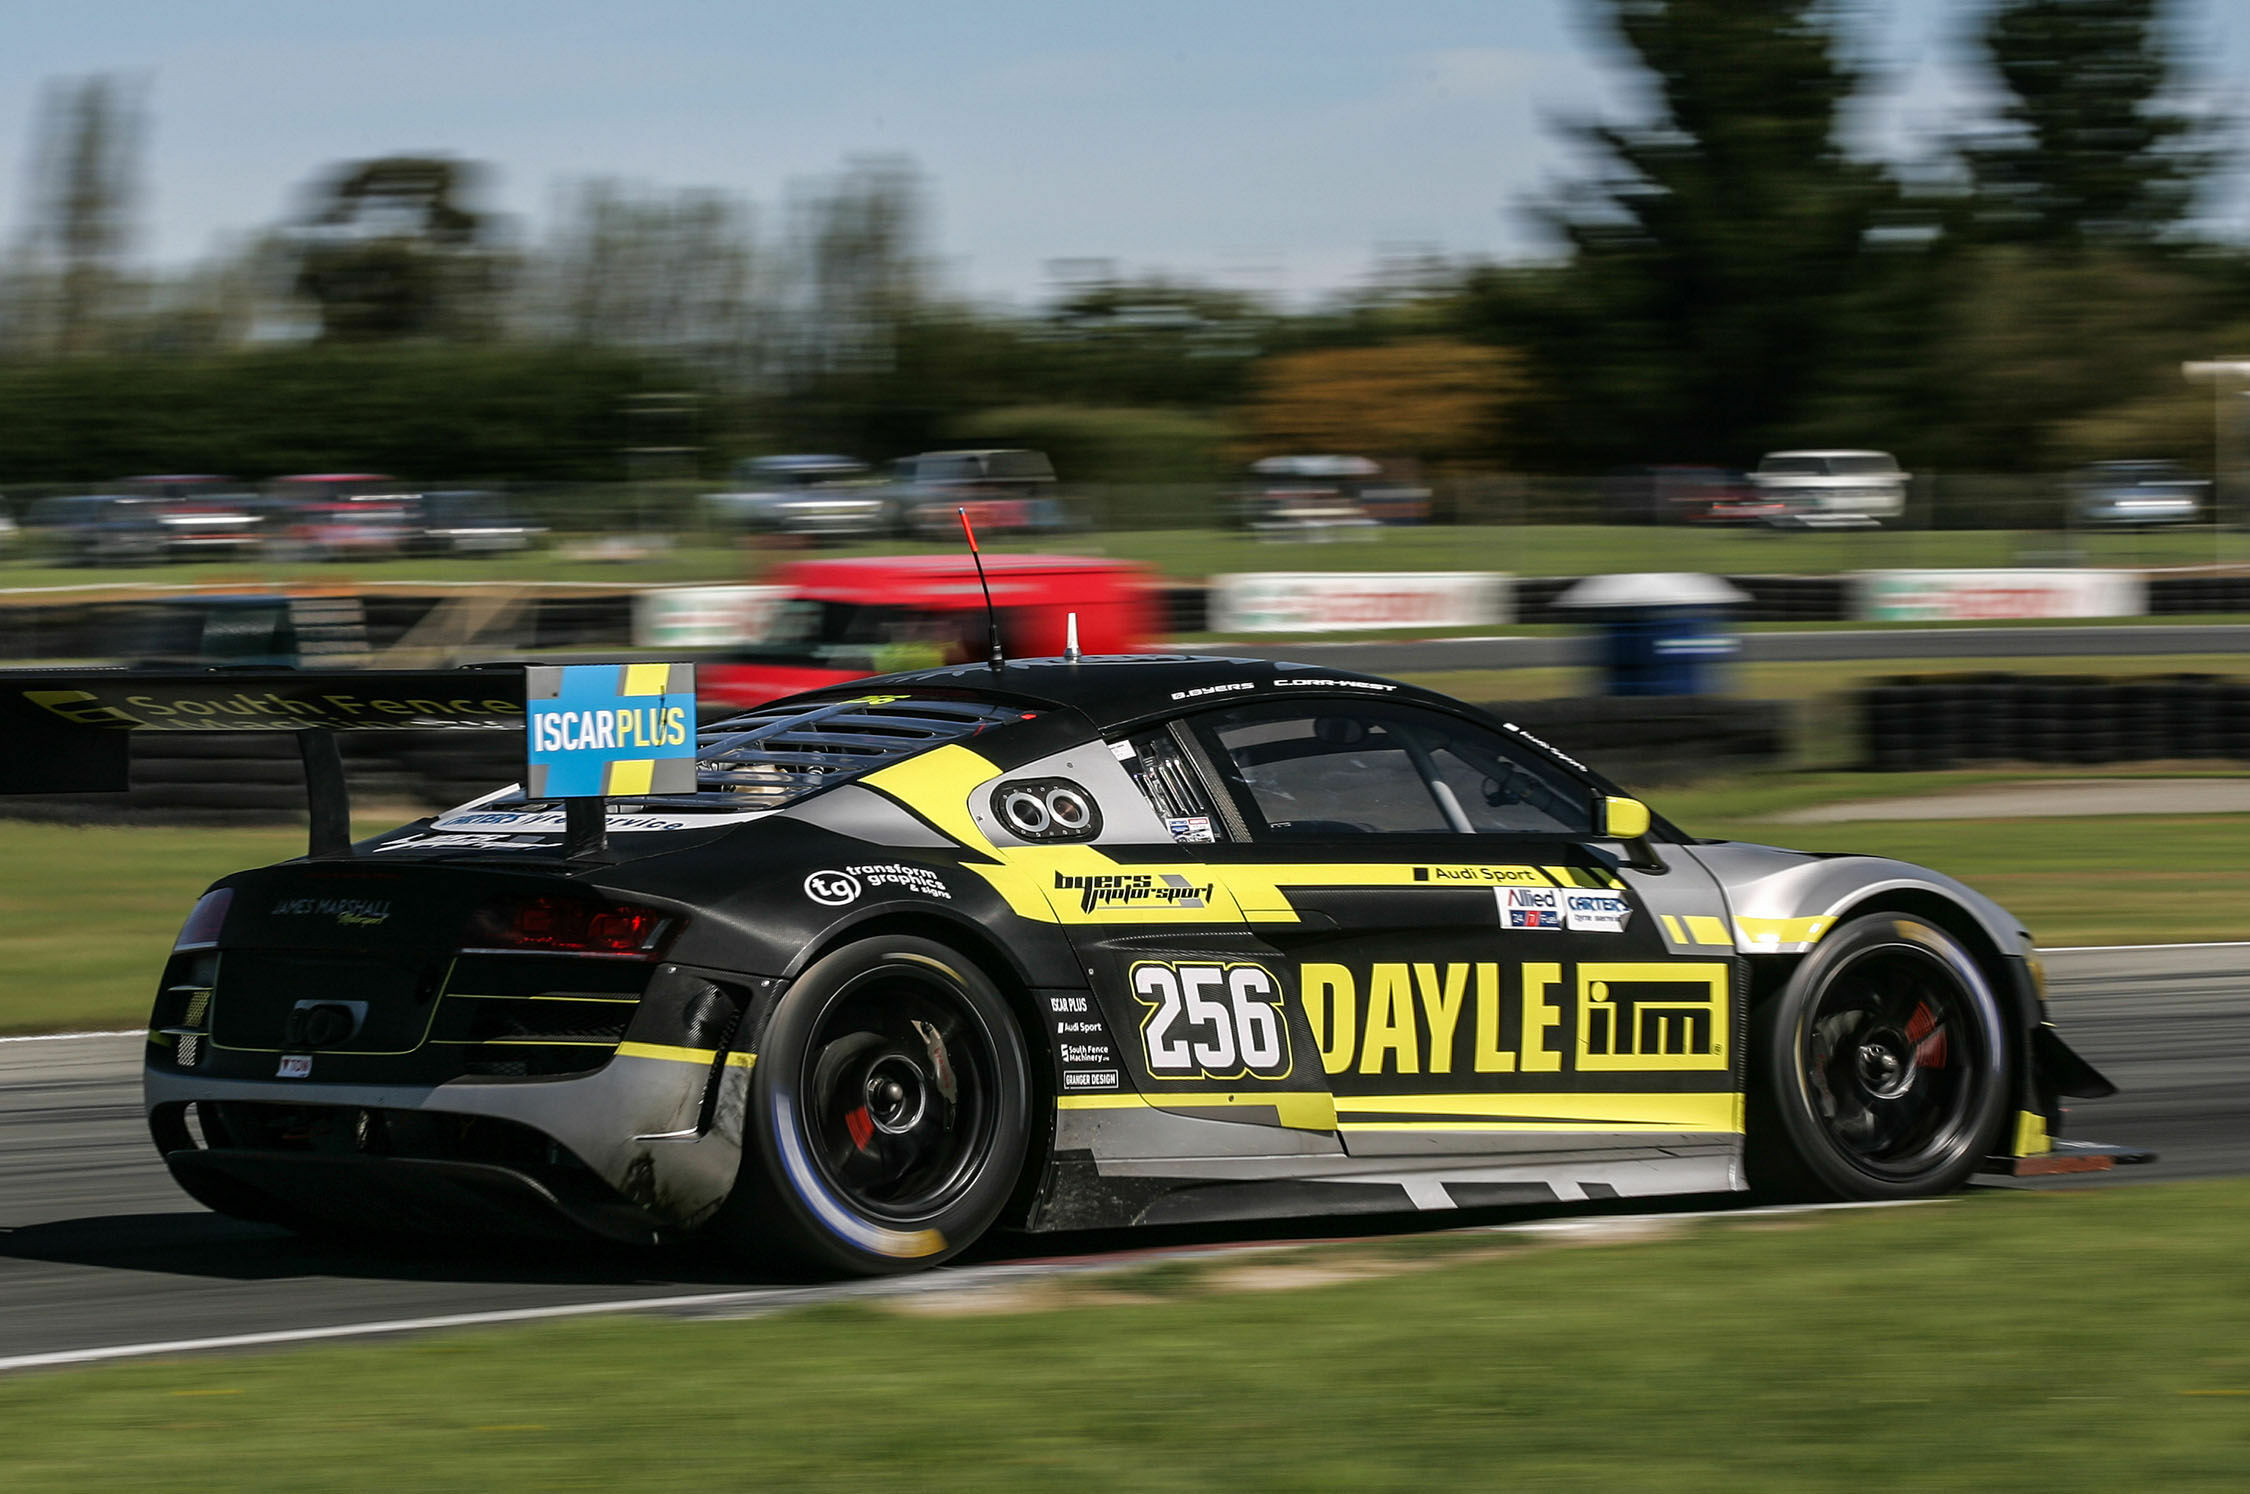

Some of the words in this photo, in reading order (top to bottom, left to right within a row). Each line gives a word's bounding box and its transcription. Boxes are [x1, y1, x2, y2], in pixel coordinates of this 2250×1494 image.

[125, 693, 327, 716] South
[319, 694, 526, 716] Fence
[533, 706, 687, 752] ISCARPLUS
[846, 863, 937, 880] transform
[1436, 867, 1478, 880] Audi
[1480, 867, 1535, 882] Sport
[811, 877, 854, 902] tg
[867, 872, 946, 890] graphics
[909, 883, 920, 892] &
[920, 886, 951, 900] signs
[1055, 869, 1152, 914] byers
[1087, 883, 1214, 915] motorsport
[1507, 888, 1557, 907] Allied
[1134, 966, 1281, 1069] 256
[1300, 961, 1562, 1075] DAYLE
[1064, 1021, 1079, 1032] Audi
[1080, 1021, 1103, 1034] Sport
[1068, 1045, 1087, 1054] South
[1087, 1045, 1109, 1054] Fence
[1069, 1052, 1103, 1063] Machinery
[1091, 1073, 1116, 1085] DESIGN
